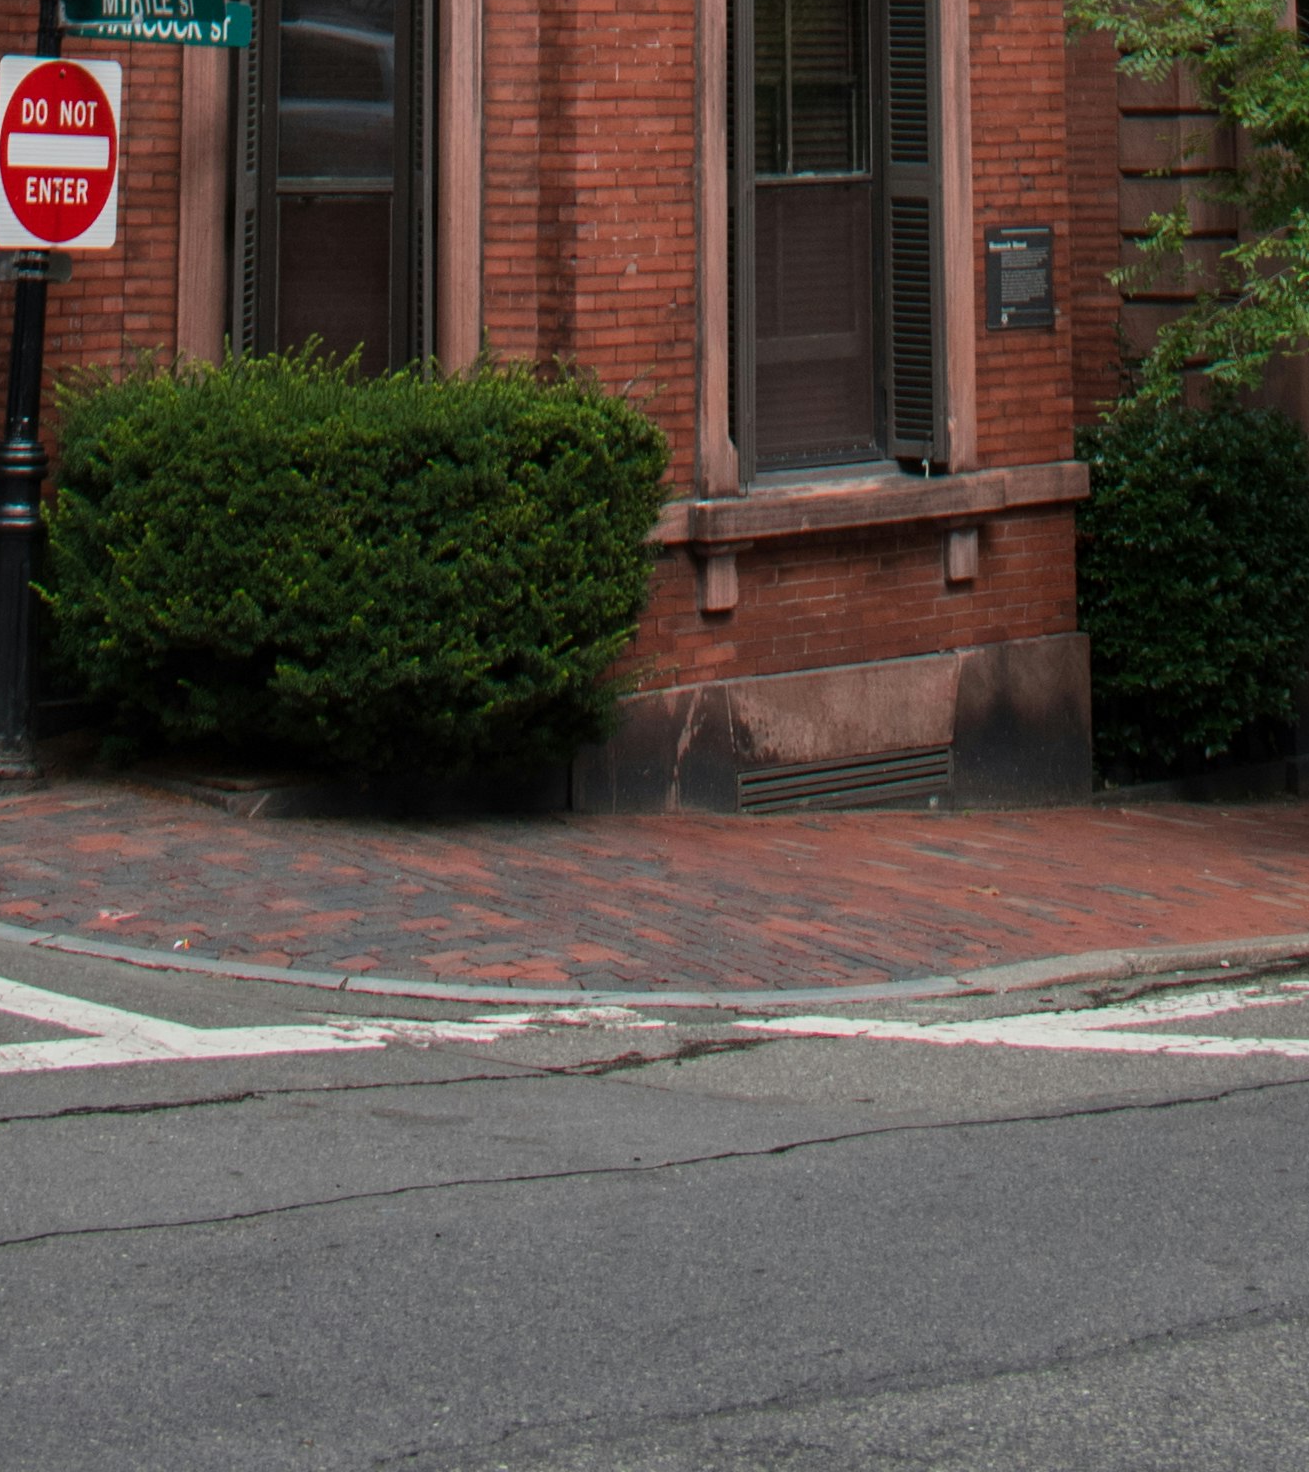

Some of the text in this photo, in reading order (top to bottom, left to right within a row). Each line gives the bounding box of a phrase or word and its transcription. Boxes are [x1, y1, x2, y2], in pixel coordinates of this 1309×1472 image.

[22, 97, 98, 128] DO NOT
[26, 175, 89, 204] ENTER
